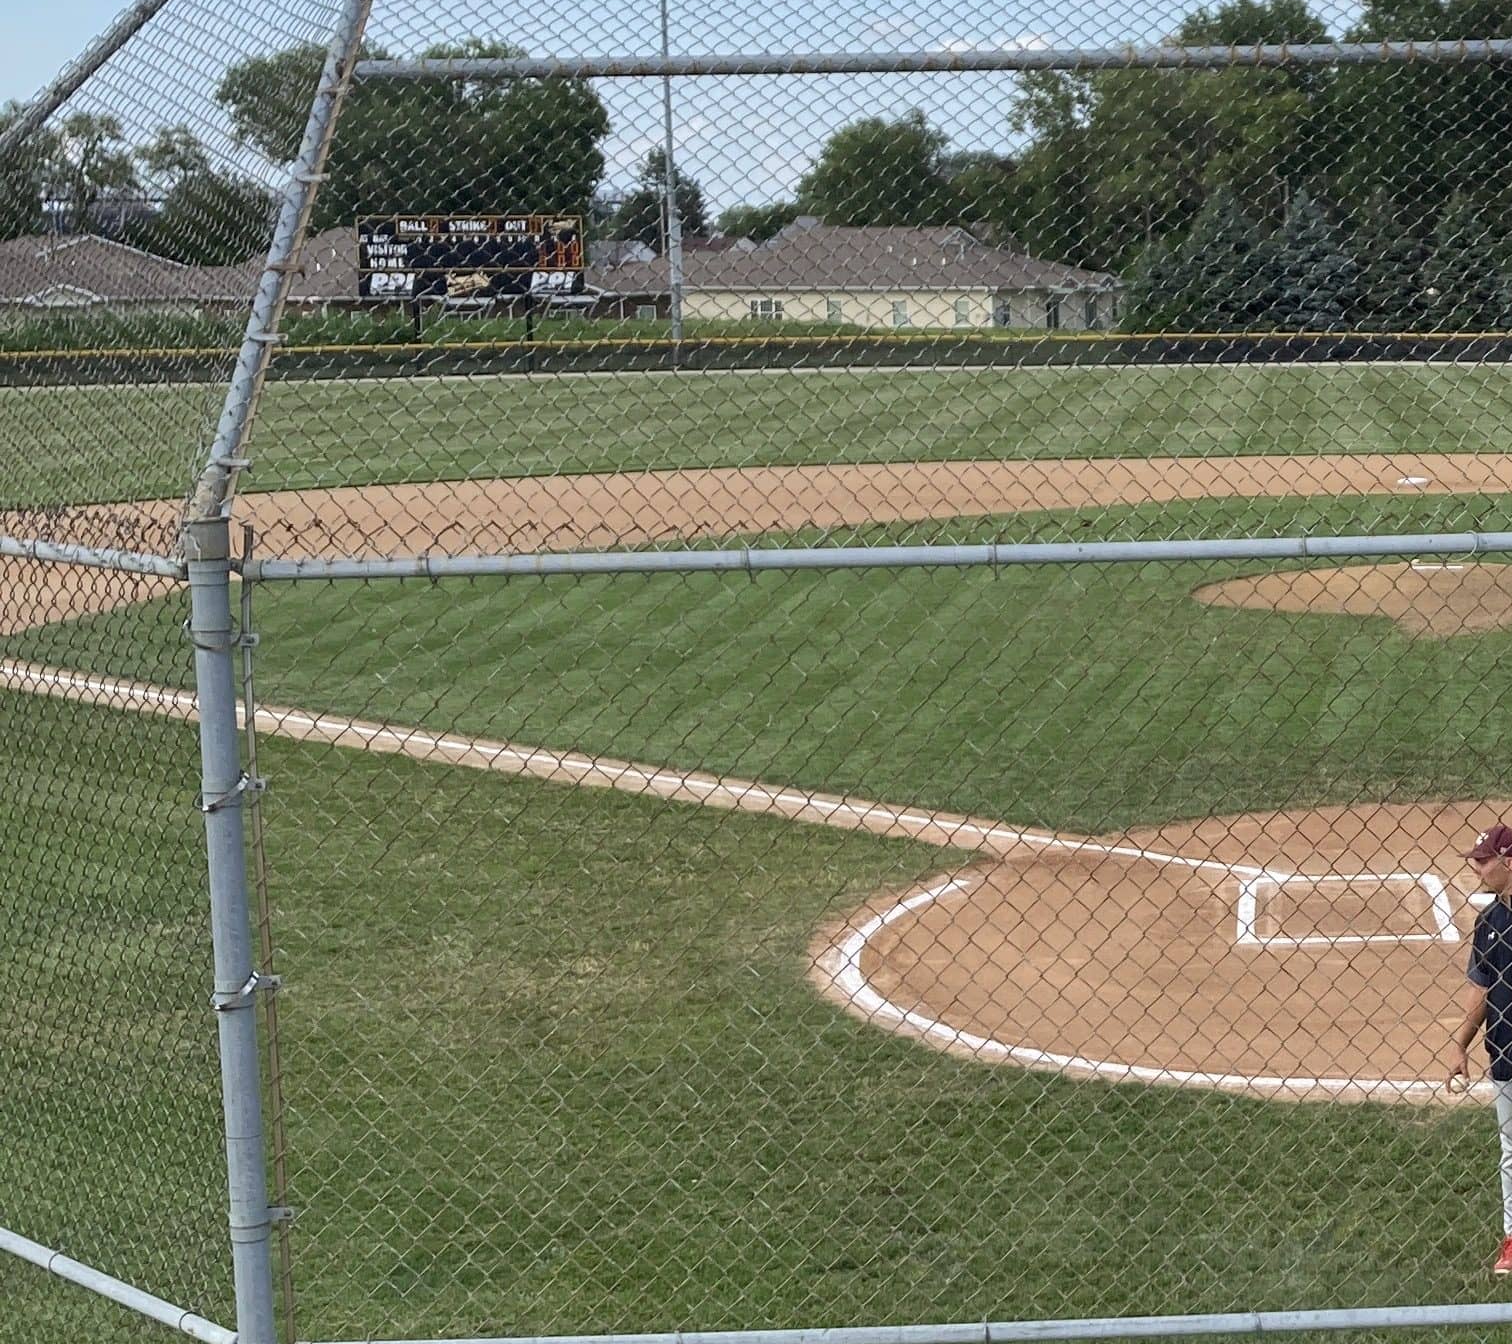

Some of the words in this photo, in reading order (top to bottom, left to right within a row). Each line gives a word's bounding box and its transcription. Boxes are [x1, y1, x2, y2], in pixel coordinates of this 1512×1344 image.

[399, 220, 428, 232] BALL
[448, 220, 486, 231] STRIKE
[505, 220, 527, 231] OUT
[367, 243, 408, 256] VISITOR
[370, 257, 405, 269] HOME
